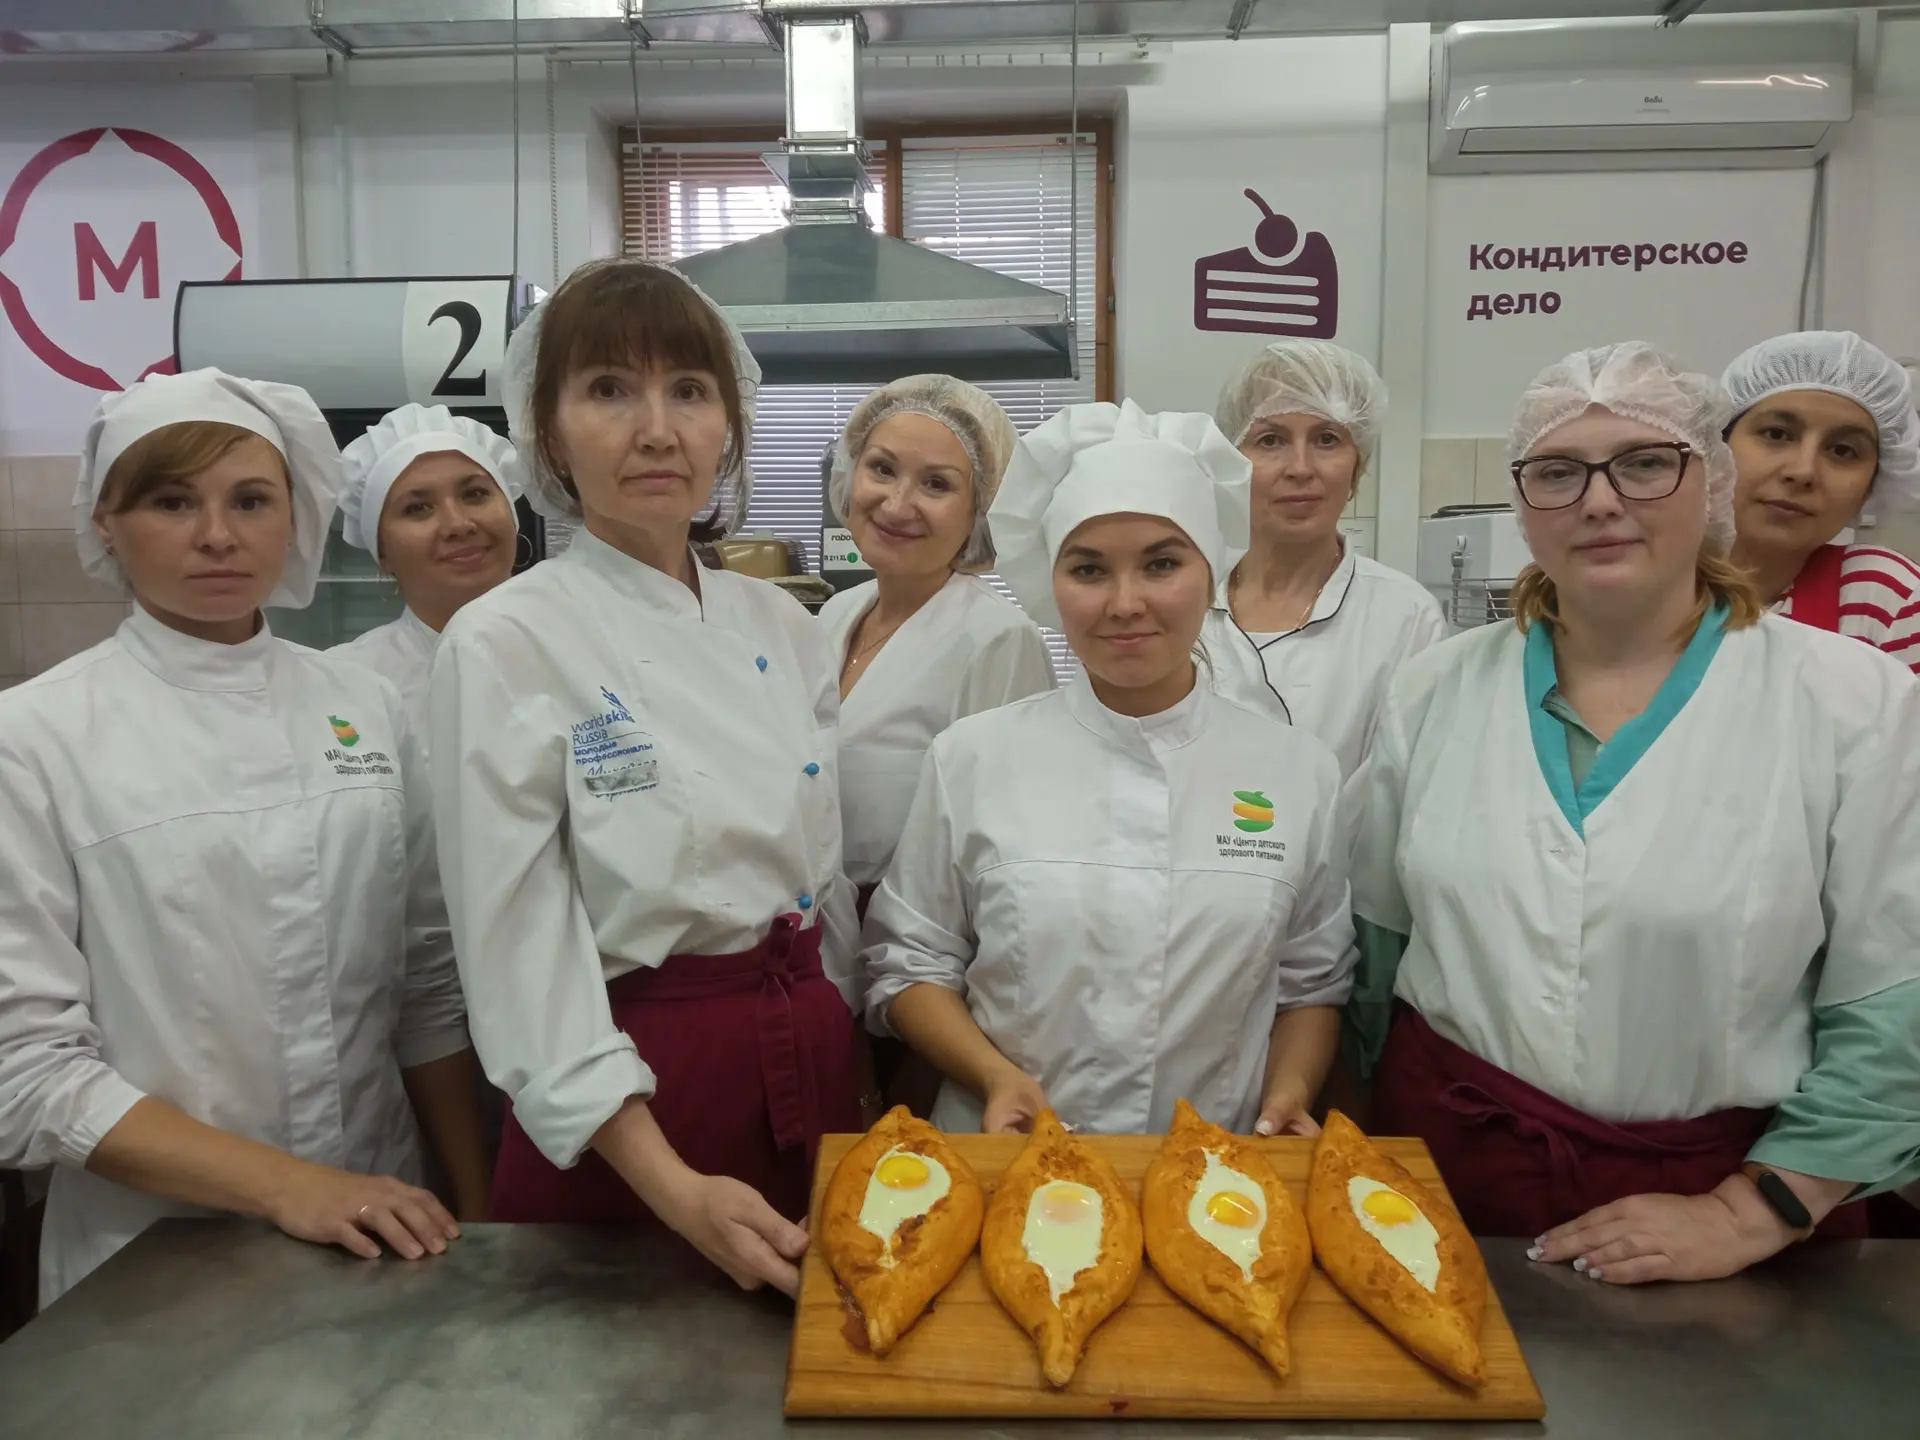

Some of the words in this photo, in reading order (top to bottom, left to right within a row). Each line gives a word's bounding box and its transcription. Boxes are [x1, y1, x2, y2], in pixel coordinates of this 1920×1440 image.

[1469, 240, 1748, 272] Кондитерское
[1467, 291, 1562, 321] дело
[427, 300, 486, 396] 2
[572, 729, 608, 745] Russia
[574, 741, 617, 757] молодые
[575, 743, 653, 766] профессионалы
[1216, 835, 1231, 845] МАУ
[1258, 840, 1286, 851] детского
[1219, 848, 1255, 859] здорового
